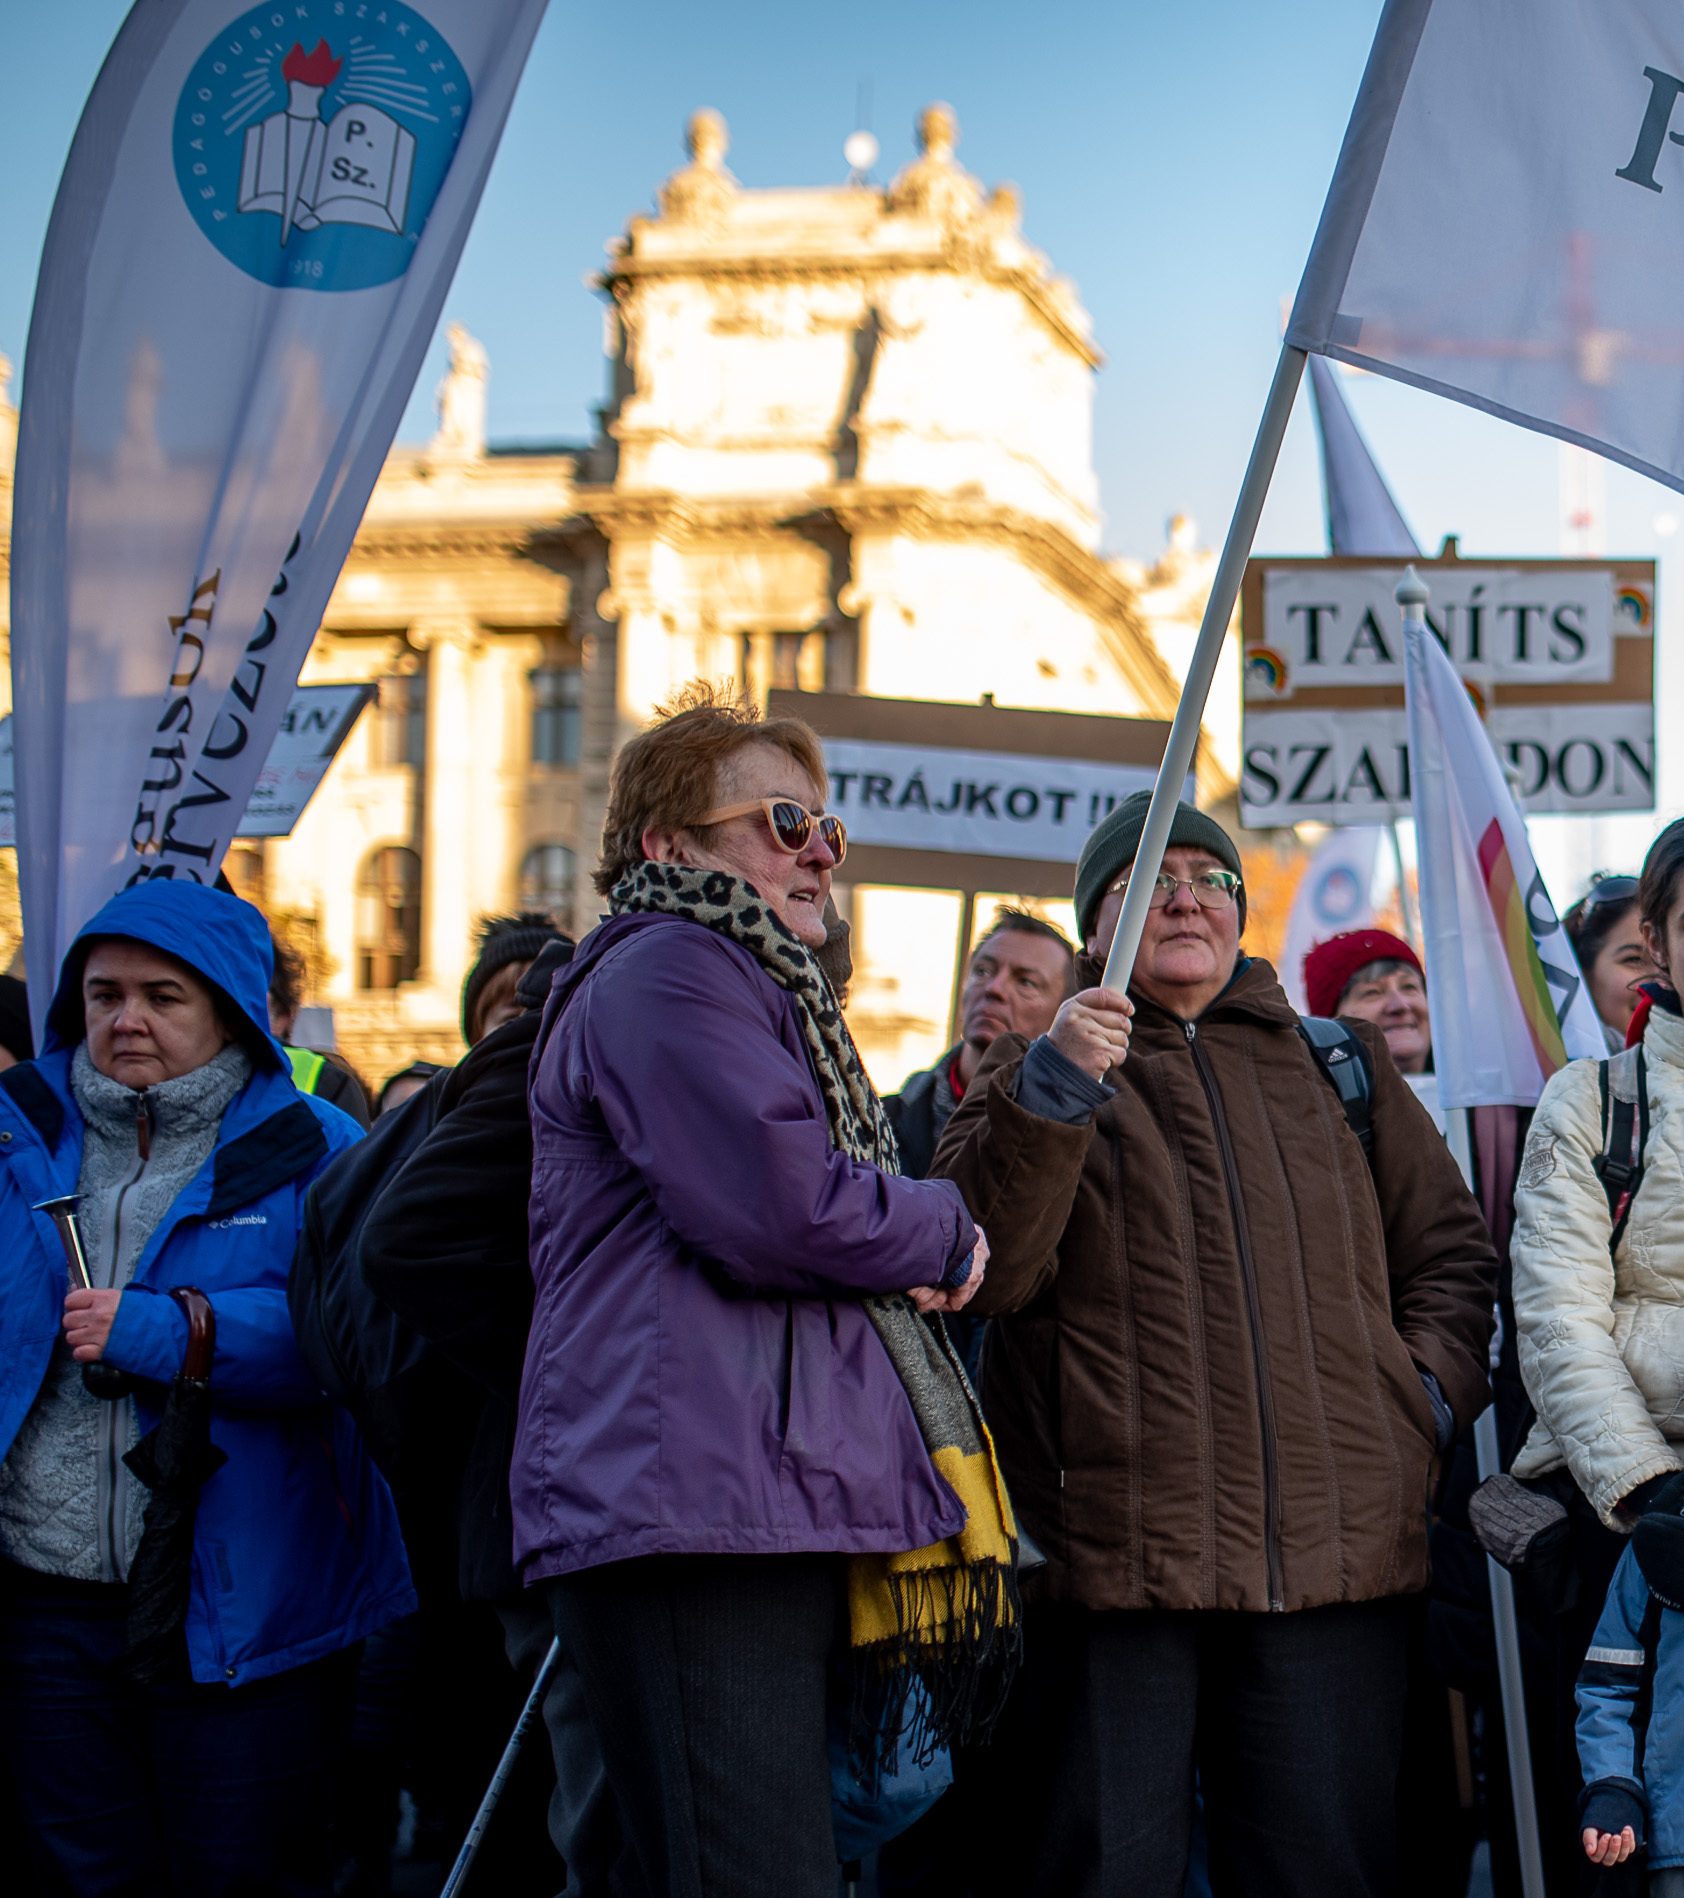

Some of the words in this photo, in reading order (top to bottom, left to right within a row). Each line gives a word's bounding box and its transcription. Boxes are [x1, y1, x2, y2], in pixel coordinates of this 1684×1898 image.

[345, 120, 374, 149] P.
[331, 156, 376, 190] Sz.
[1241, 734, 1655, 808] SZADON
[828, 764, 1077, 826] TRÁJKOT
[220, 1214, 267, 1229] Columbia
